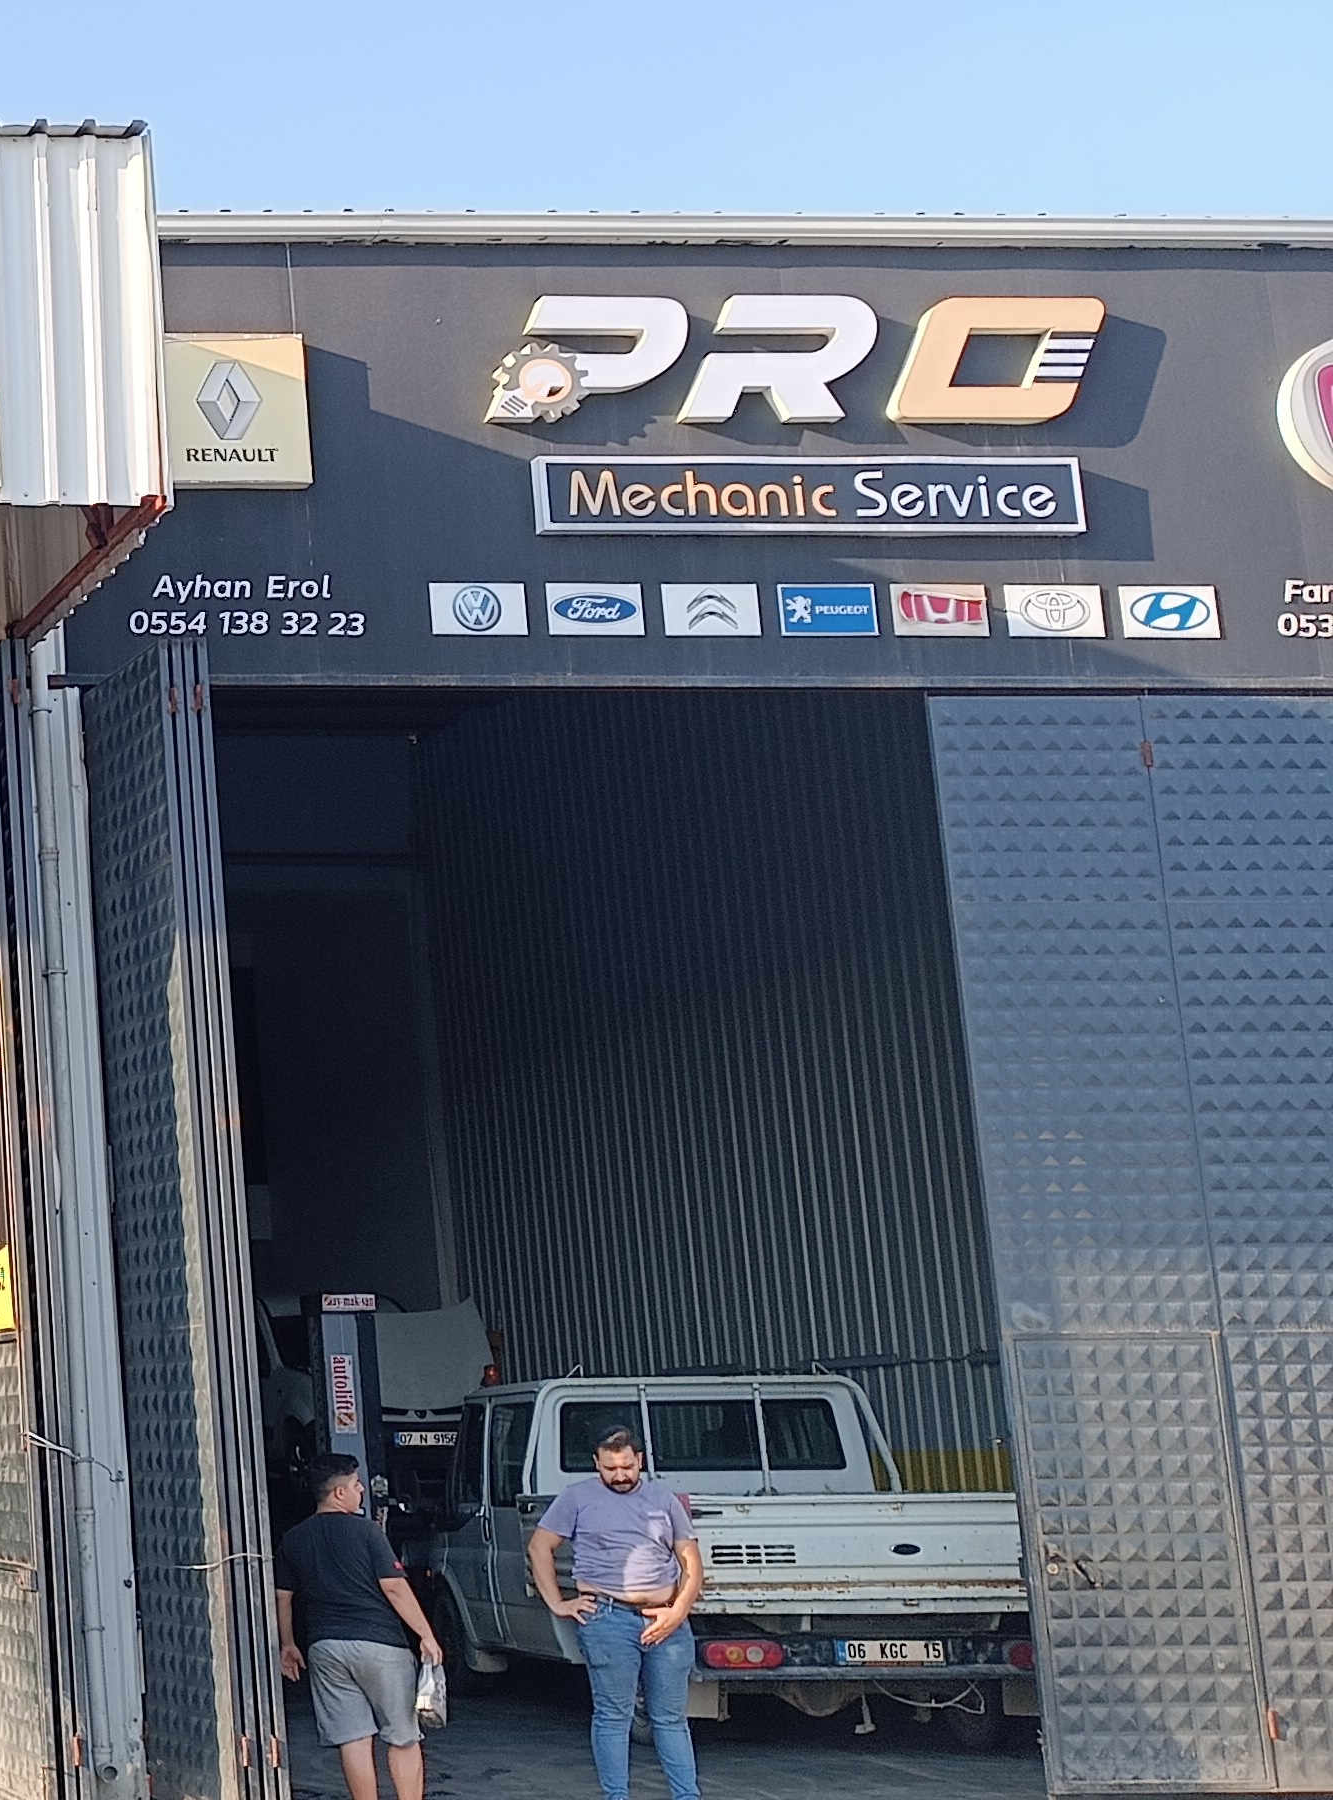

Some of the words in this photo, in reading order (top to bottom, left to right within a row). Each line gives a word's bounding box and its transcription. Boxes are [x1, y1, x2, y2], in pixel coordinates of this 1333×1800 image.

[185, 446, 279, 464] RENAULT
[568, 469, 838, 518] Mechanic
[855, 469, 1057, 519] Service
[152, 574, 252, 606] Ayhan
[266, 574, 332, 601] Erol
[815, 605, 870, 615] PEUGEOT
[129, 611, 208, 636] 0554
[218, 611, 269, 636] 138
[281, 611, 320, 637] 32
[327, 612, 365, 638] 23
[333, 1356, 354, 1412] autolift
[400, 1433, 413, 1444] 07
[420, 1433, 428, 1444] N
[847, 1643, 866, 1659] 06
[880, 1642, 908, 1659] KGC
[923, 1642, 941, 1659] 15
